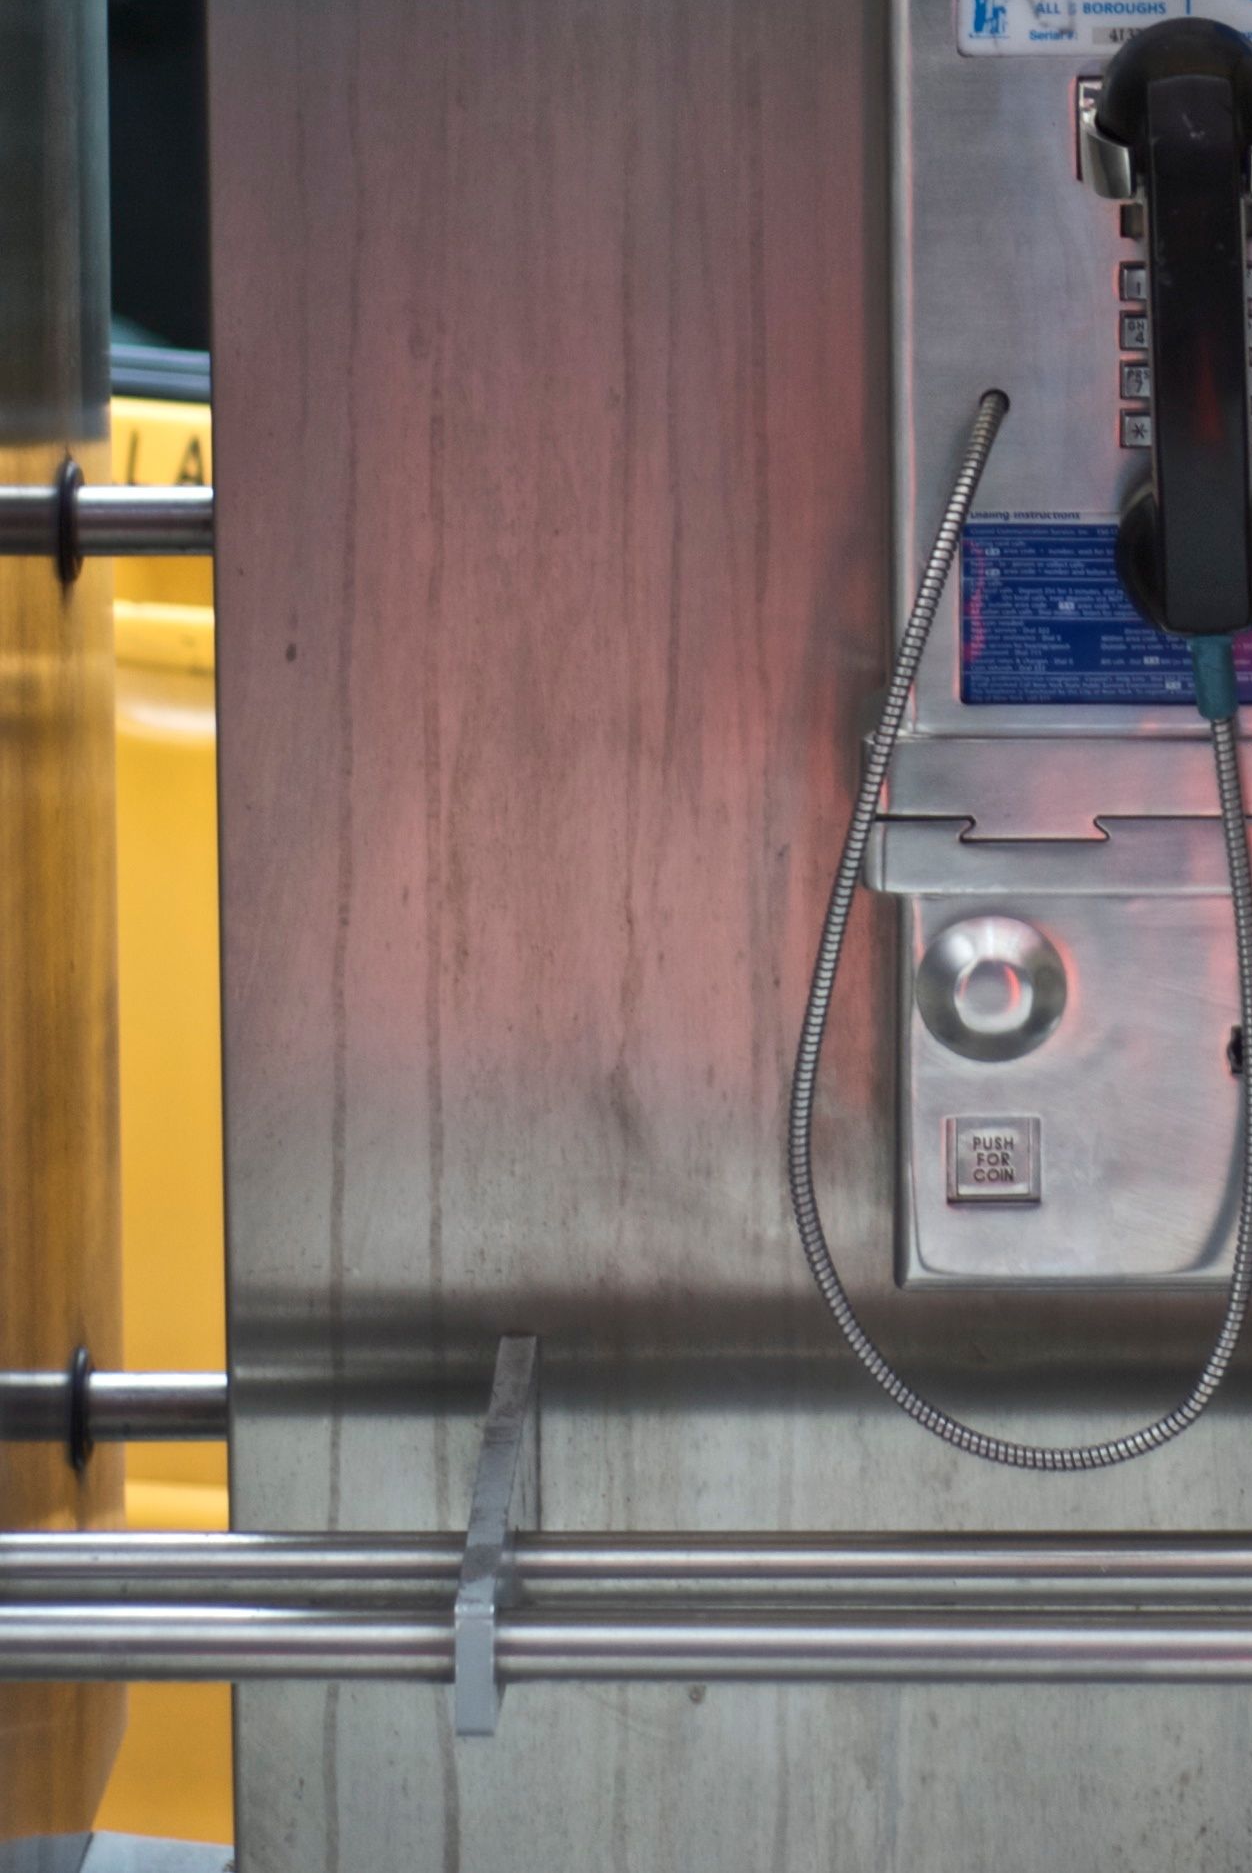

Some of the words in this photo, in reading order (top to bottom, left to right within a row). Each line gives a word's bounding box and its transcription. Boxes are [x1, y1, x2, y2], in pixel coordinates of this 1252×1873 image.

[1036, 2, 1061, 16] ALL
[1083, 2, 1167, 16] BOROUGHS
[972, 1136, 1015, 1151] PUSH
[976, 1153, 1011, 1166] FOR
[973, 1168, 1015, 1183] COIN
